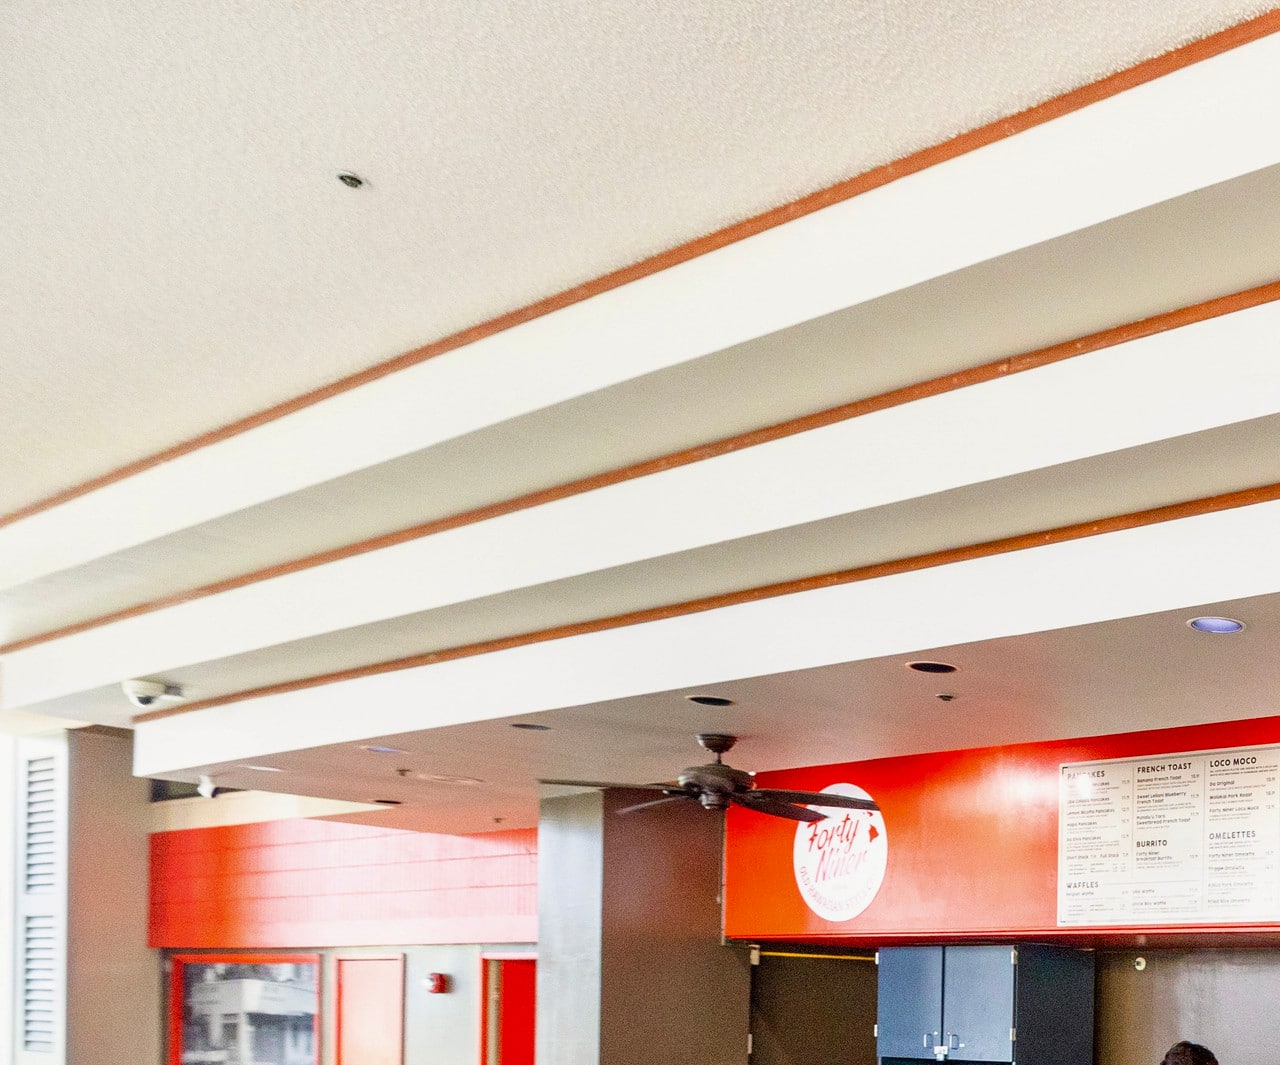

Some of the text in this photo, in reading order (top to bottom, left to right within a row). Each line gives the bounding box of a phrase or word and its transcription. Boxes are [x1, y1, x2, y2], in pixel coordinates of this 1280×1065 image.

[1137, 762, 1192, 773] FRENCH TOAST
[1210, 756, 1257, 768] LOCO MOCO
[807, 813, 860, 854] Forty
[1209, 830, 1256, 840] OMELETTES
[1136, 840, 1168, 848] BURRITO
